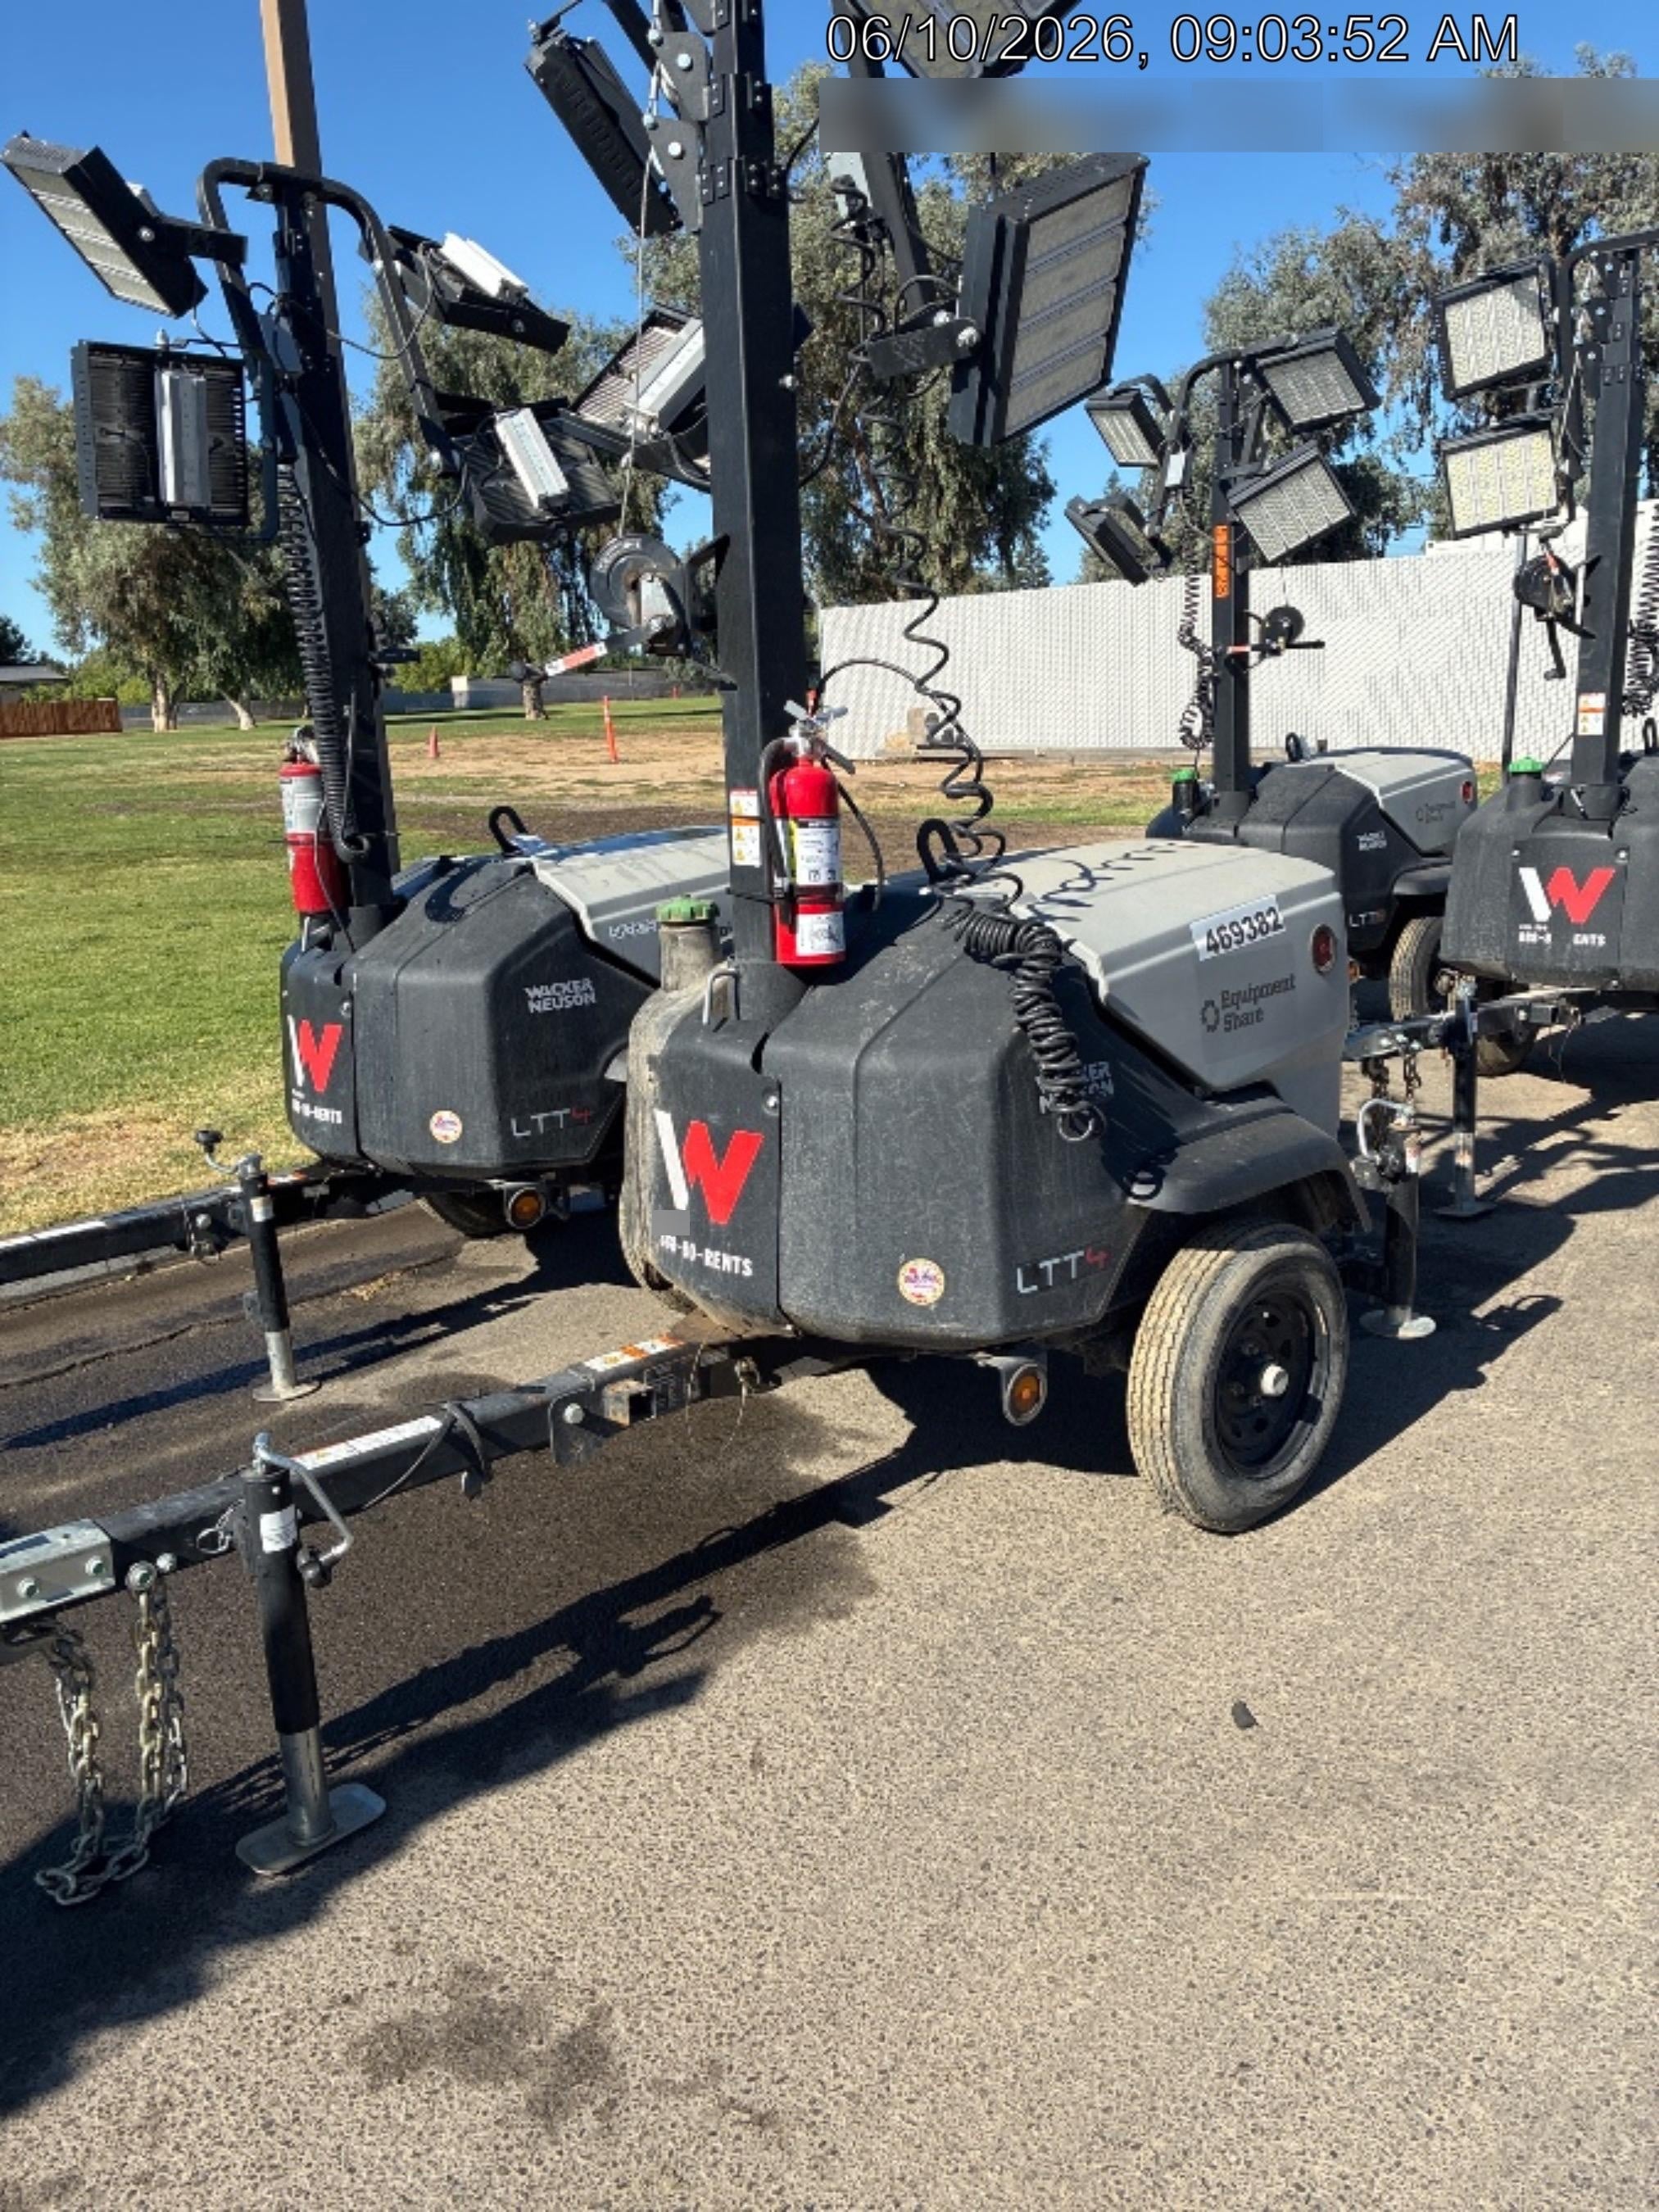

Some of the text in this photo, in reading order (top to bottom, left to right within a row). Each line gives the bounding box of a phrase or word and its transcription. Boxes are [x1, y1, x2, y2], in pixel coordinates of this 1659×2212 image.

[1206, 906, 1284, 954] 469382
[528, 990, 596, 1013] NEUSON
[1221, 972, 1296, 1010] Equipment
[510, 1108, 590, 1136] LTT4
[1017, 1247, 1106, 1294] LTT4
